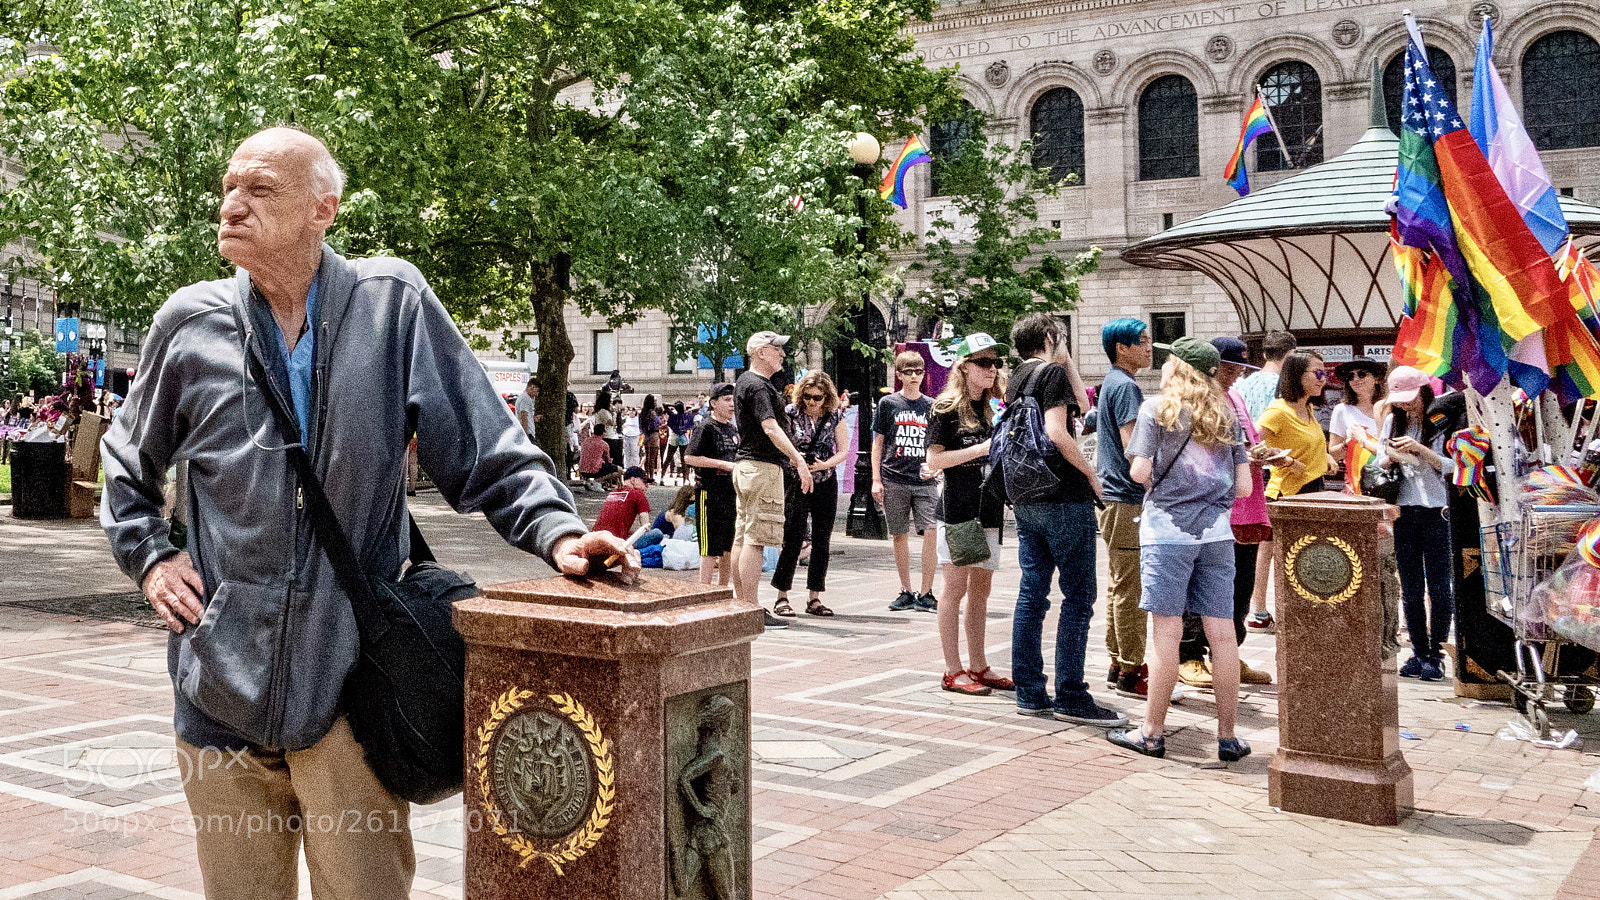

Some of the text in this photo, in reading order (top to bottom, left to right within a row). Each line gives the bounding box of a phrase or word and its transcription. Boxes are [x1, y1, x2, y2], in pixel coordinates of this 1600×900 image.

[897, 41, 990, 62] EDICATED
[1006, 35, 1031, 50] TO
[1043, 28, 1081, 45] THE
[1093, 6, 1242, 39] ADVANCEMENT
[1258, 1, 1287, 18] OF
[1366, 347, 1391, 356] ARTS
[494, 372, 522, 383] STAPLES
[896, 425, 926, 438] AIDS
[895, 436, 925, 448] WALK
[903, 446, 925, 458] RUN
